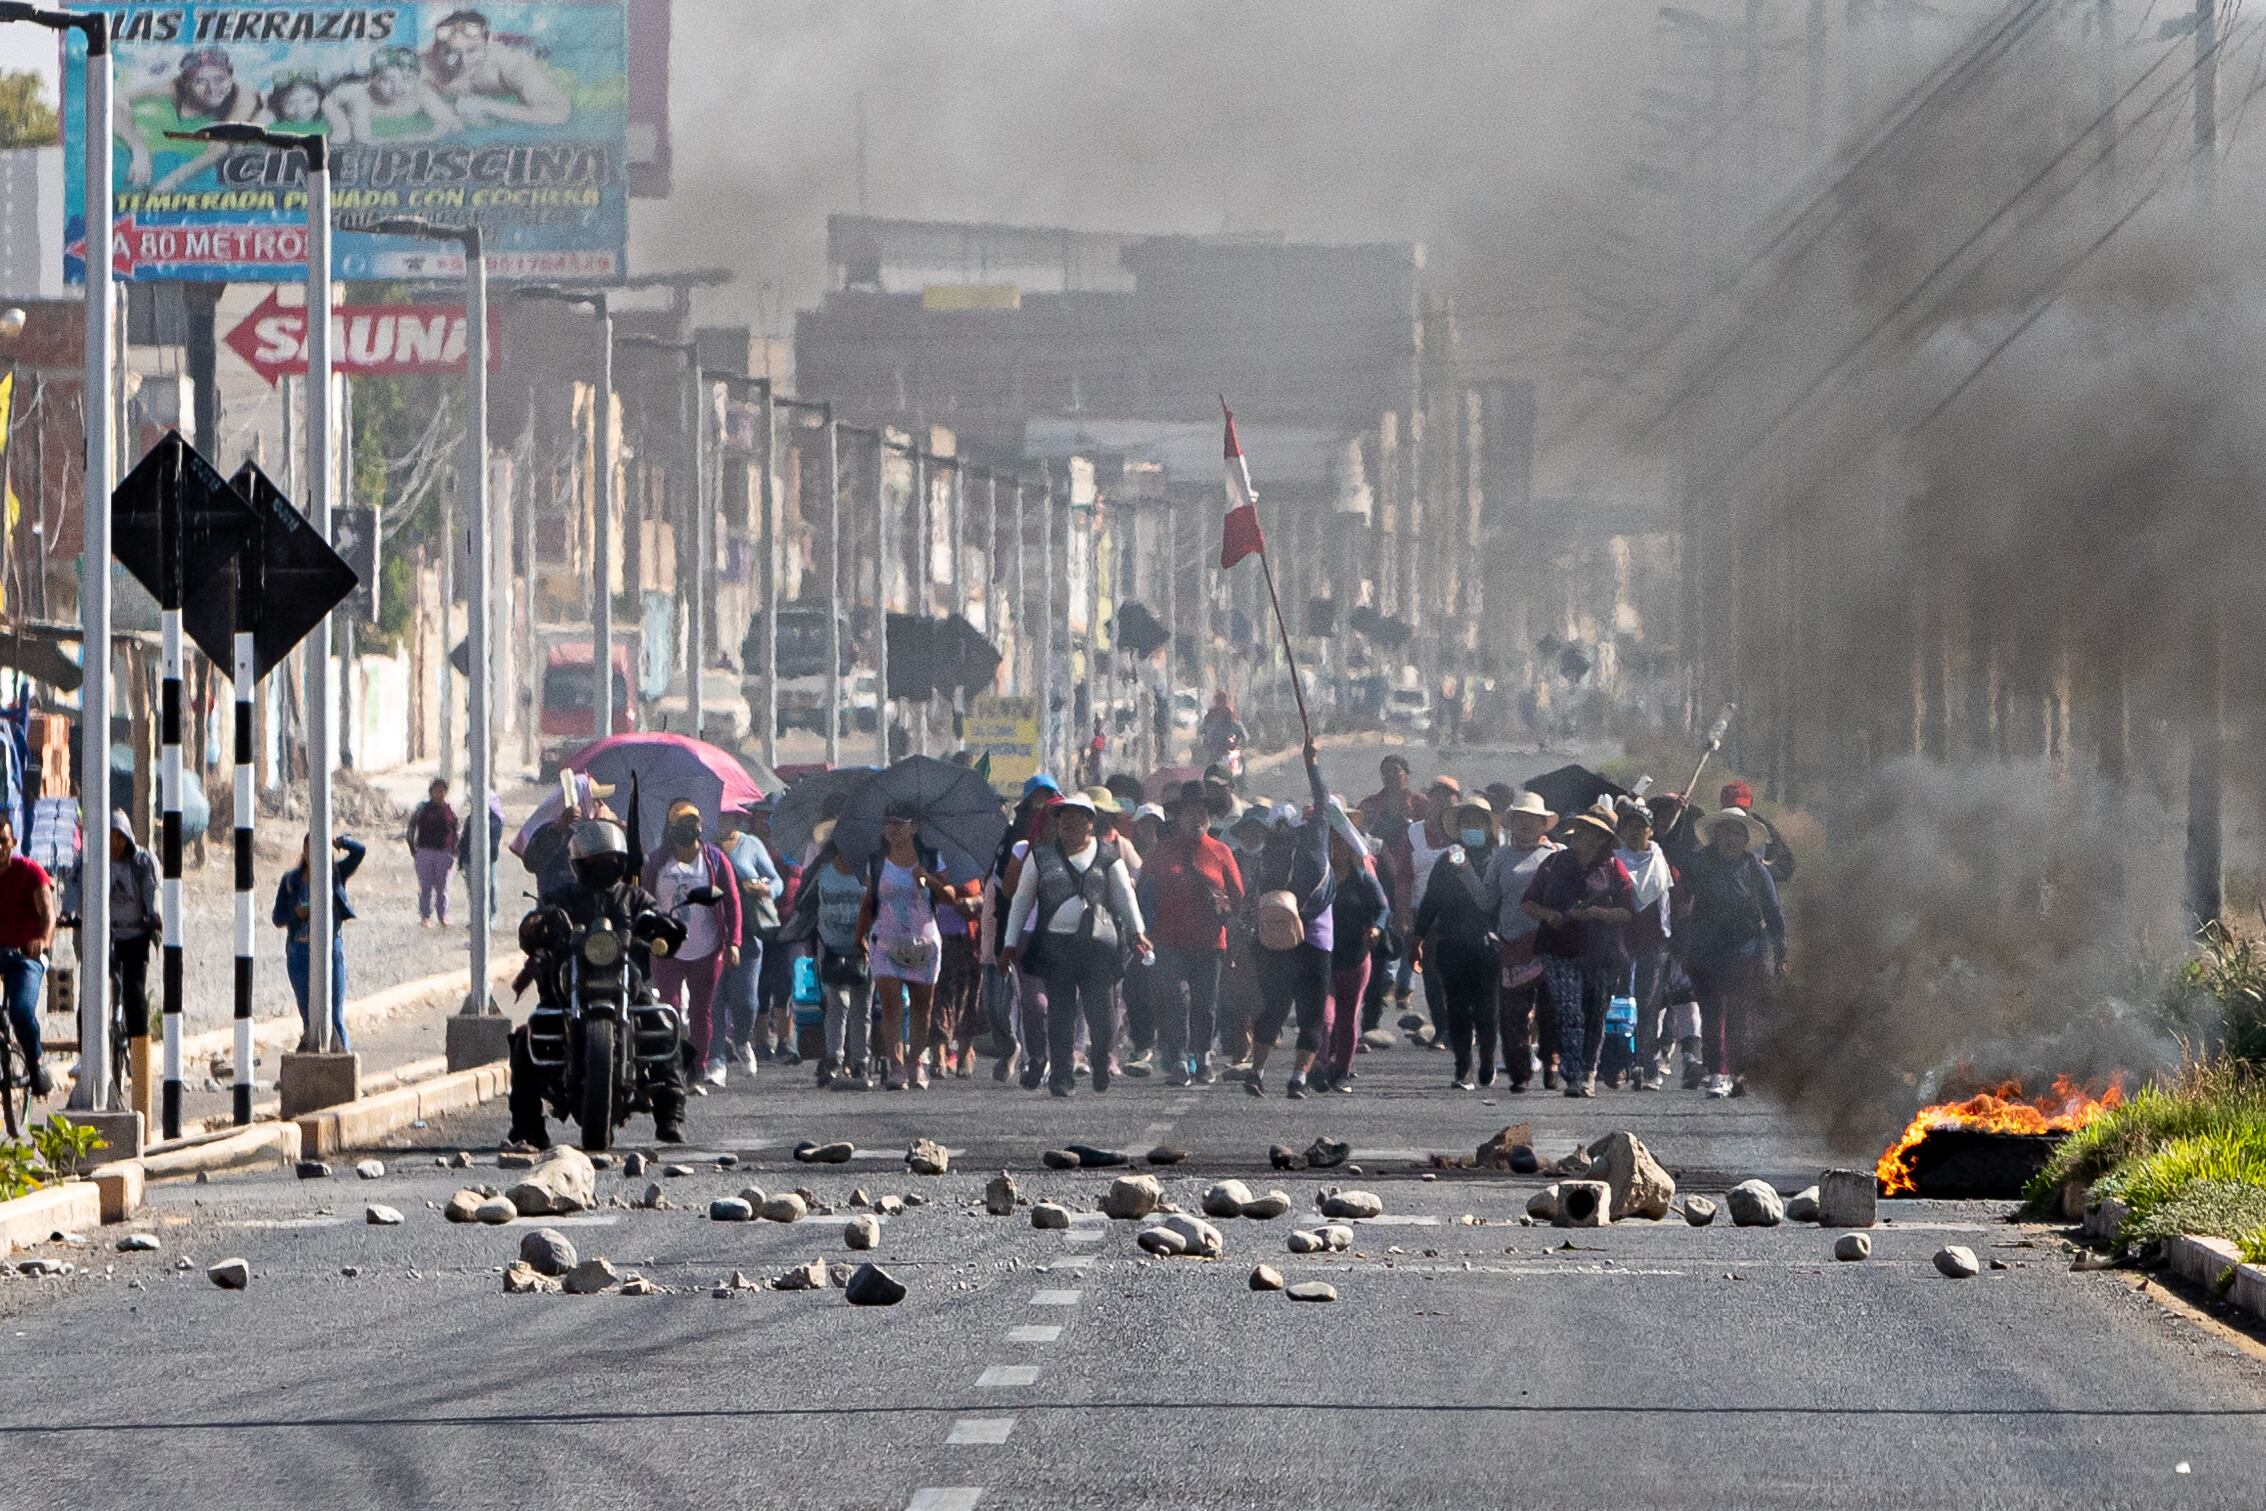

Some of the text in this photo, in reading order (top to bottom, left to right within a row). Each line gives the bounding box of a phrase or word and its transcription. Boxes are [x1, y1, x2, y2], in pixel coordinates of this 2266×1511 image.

[109, 8, 397, 42] LAS TERRAZAS
[371, 144, 612, 187] PISCINA
[408, 189, 464, 208] CON
[111, 231, 309, 261] A 80 METRO
